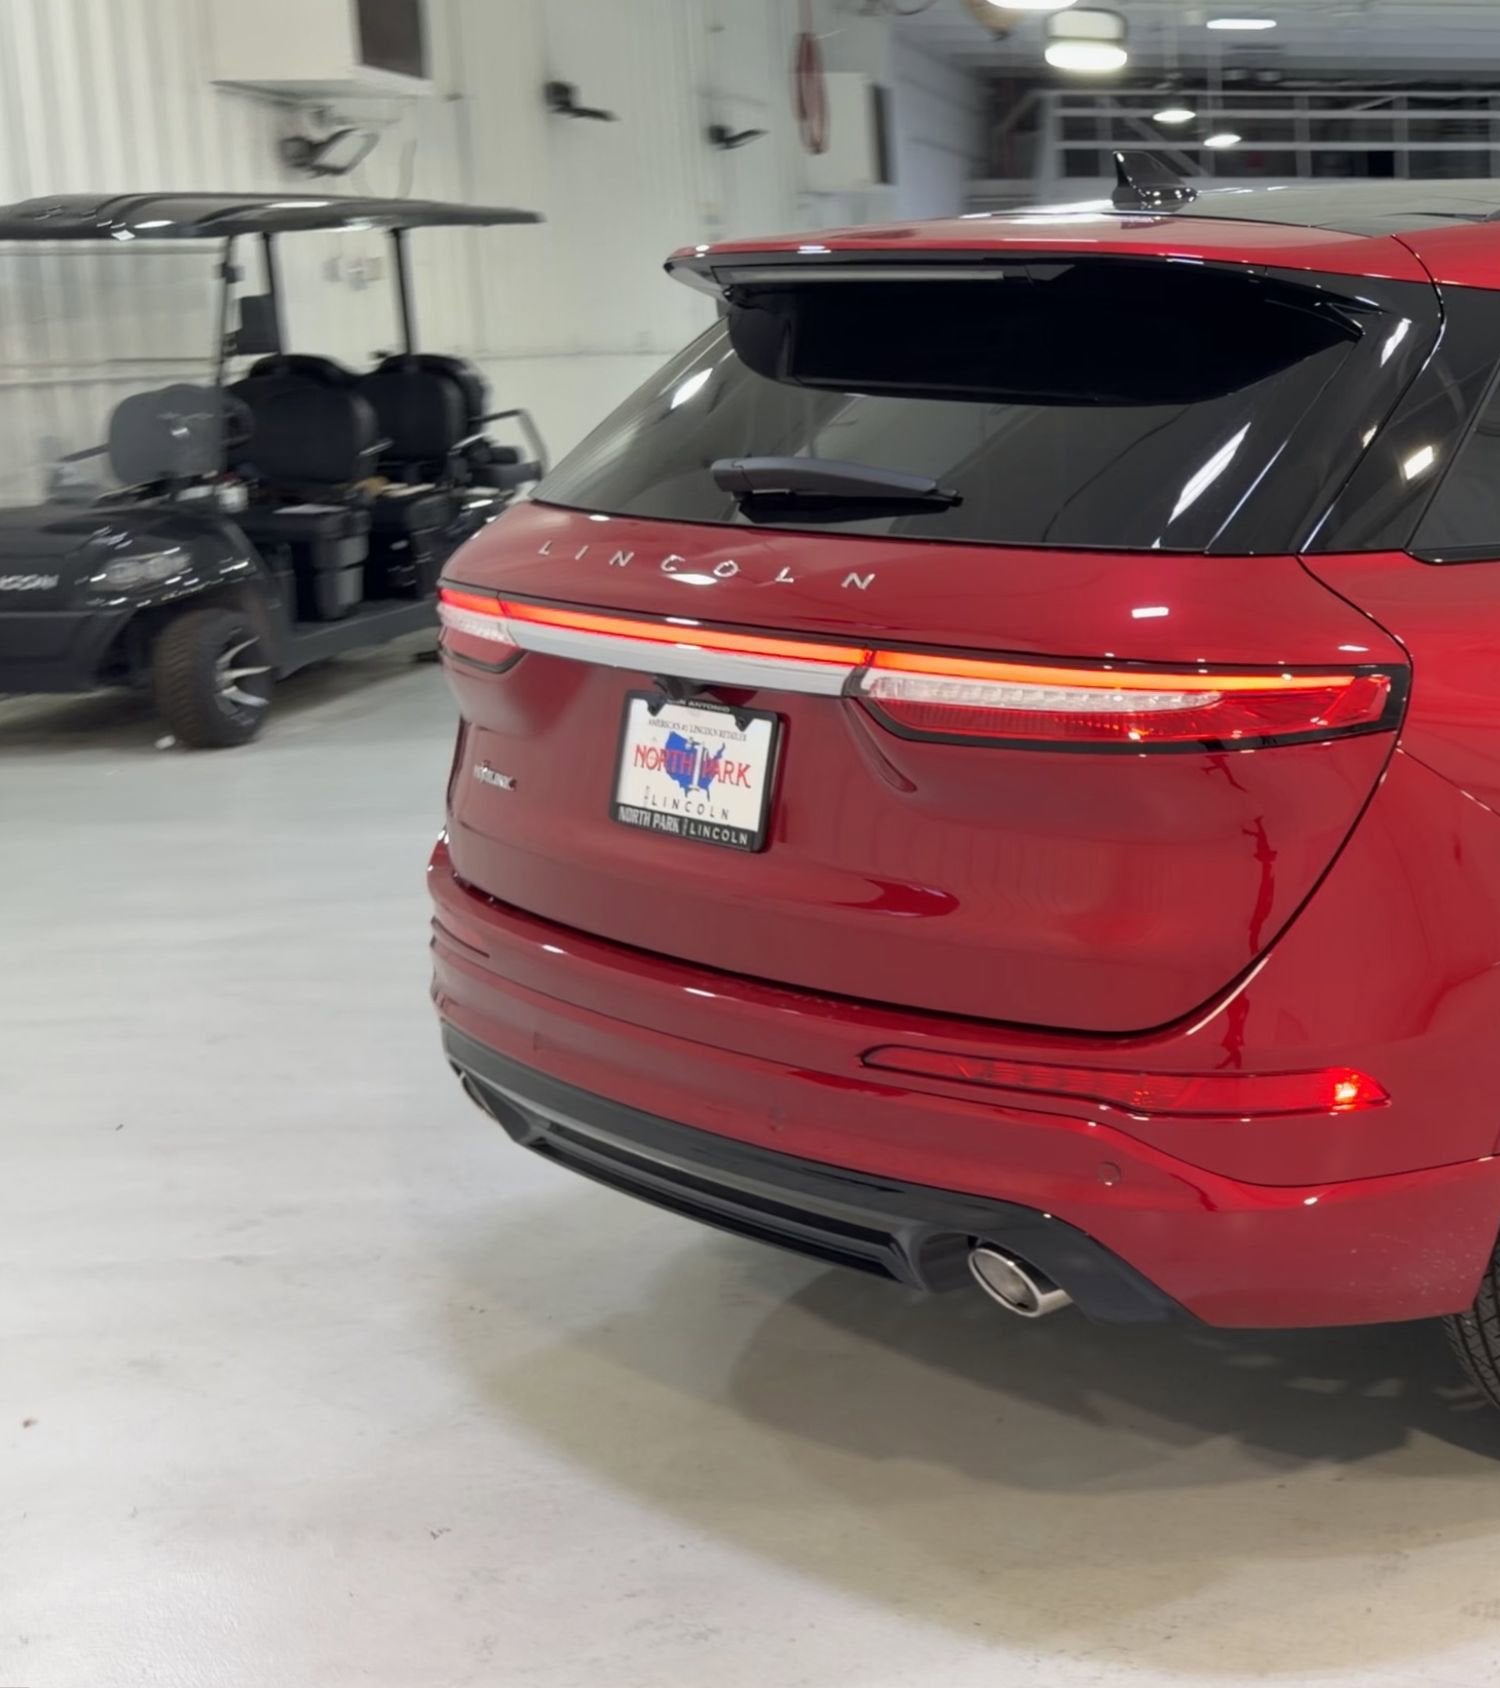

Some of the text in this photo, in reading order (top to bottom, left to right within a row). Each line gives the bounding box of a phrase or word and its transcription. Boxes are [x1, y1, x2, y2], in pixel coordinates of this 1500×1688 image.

[537, 540, 876, 590] LINCOLN
[633, 744, 752, 789] NORTH PARK
[618, 805, 748, 845] NORTH PARK LINCOLN
[651, 794, 729, 820] LINCOLN
